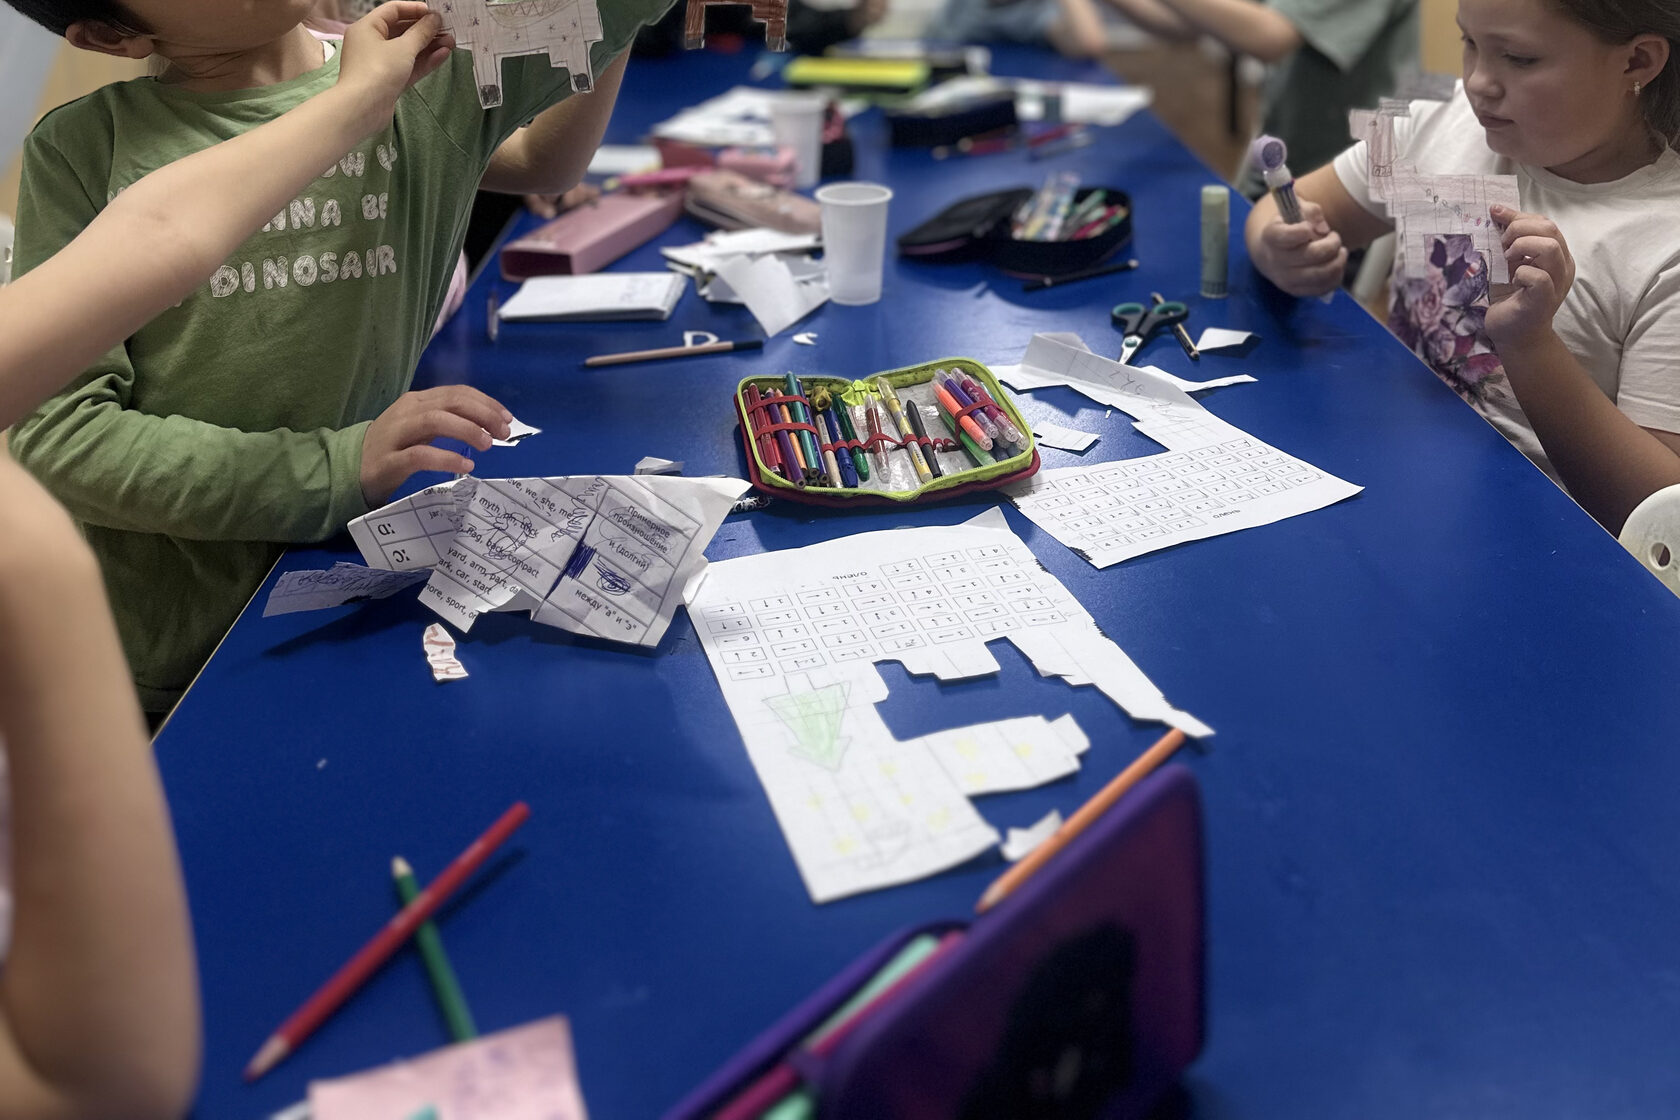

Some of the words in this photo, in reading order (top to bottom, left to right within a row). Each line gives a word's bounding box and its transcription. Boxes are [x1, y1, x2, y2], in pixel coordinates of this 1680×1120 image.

[525, 487, 538, 501] we,
[541, 497, 556, 512] she,
[613, 512, 668, 554] произношение
[627, 505, 671, 539] Примерное
[447, 546, 468, 565] yard,
[469, 560, 487, 577] arm,
[615, 543, 650, 573] (долгий)
[455, 569, 470, 583] car,
[472, 578, 492, 595] start
[445, 595, 466, 615] sport,
[575, 589, 602, 611] между
